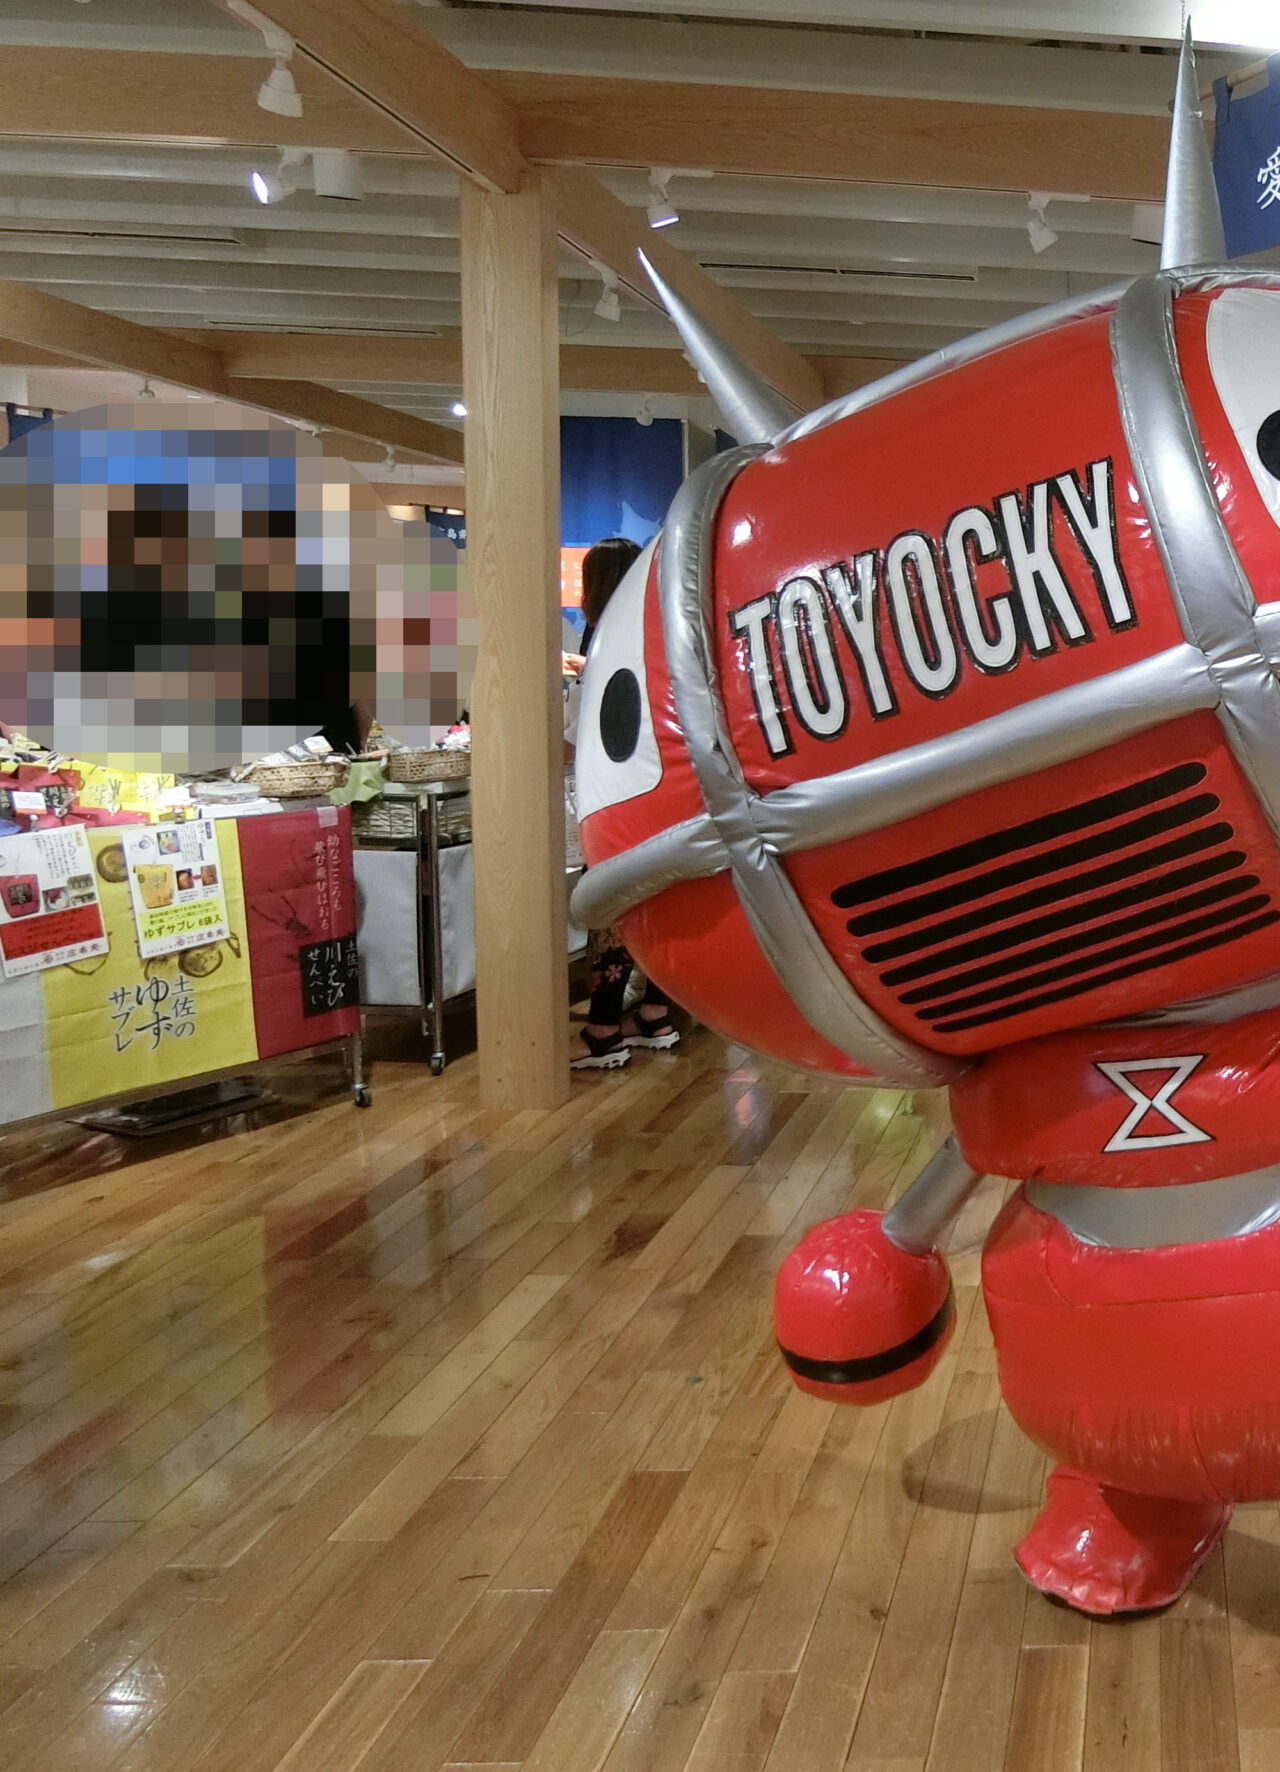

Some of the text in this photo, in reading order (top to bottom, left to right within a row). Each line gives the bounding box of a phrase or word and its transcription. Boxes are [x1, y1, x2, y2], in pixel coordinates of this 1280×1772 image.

[731, 458, 1136, 757] TOYOCKY
[144, 921, 196, 939] ゆずサブレ
[171, 975, 196, 1037] 土佐の
[308, 948, 324, 1005] せんべい
[109, 986, 135, 1052] サブレ
[136, 976, 173, 1050] ゆず
